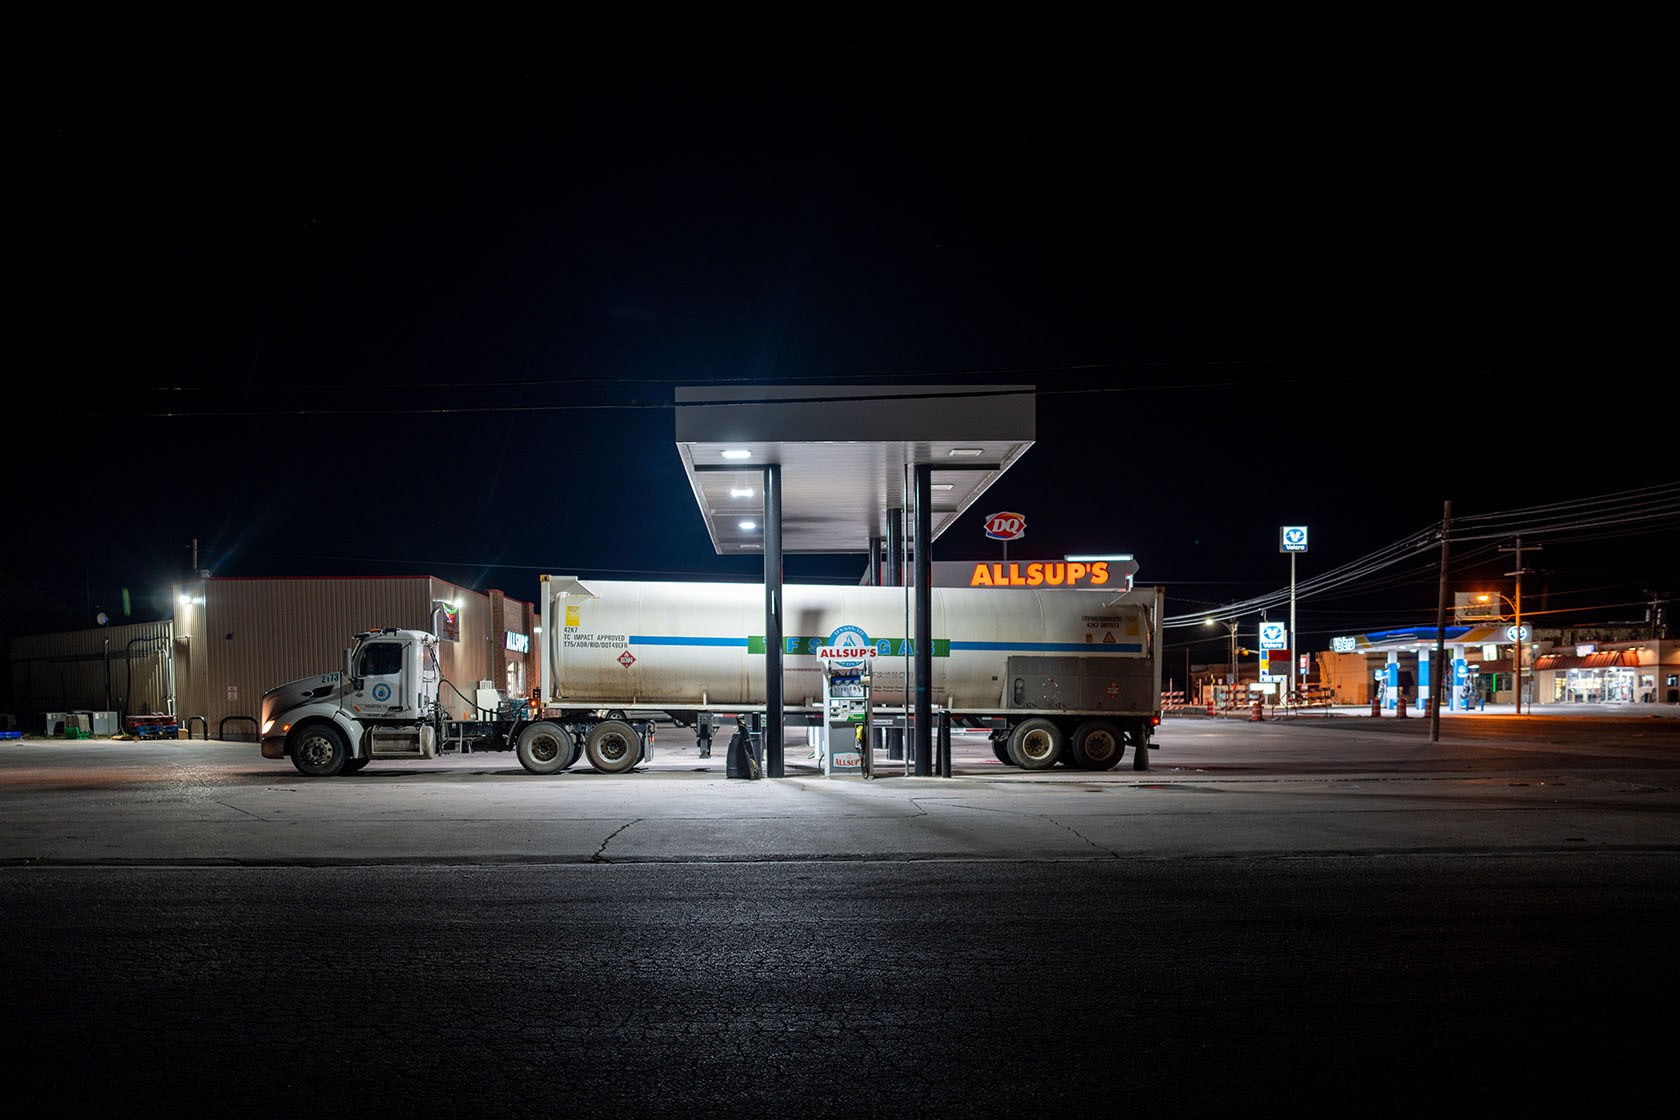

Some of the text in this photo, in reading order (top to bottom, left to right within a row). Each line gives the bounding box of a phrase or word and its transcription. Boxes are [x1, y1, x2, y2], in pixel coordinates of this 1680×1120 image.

[992, 518, 1020, 533] DQ
[970, 561, 1109, 587] ALLSUP'S
[820, 648, 877, 658] ALLSUP'S
